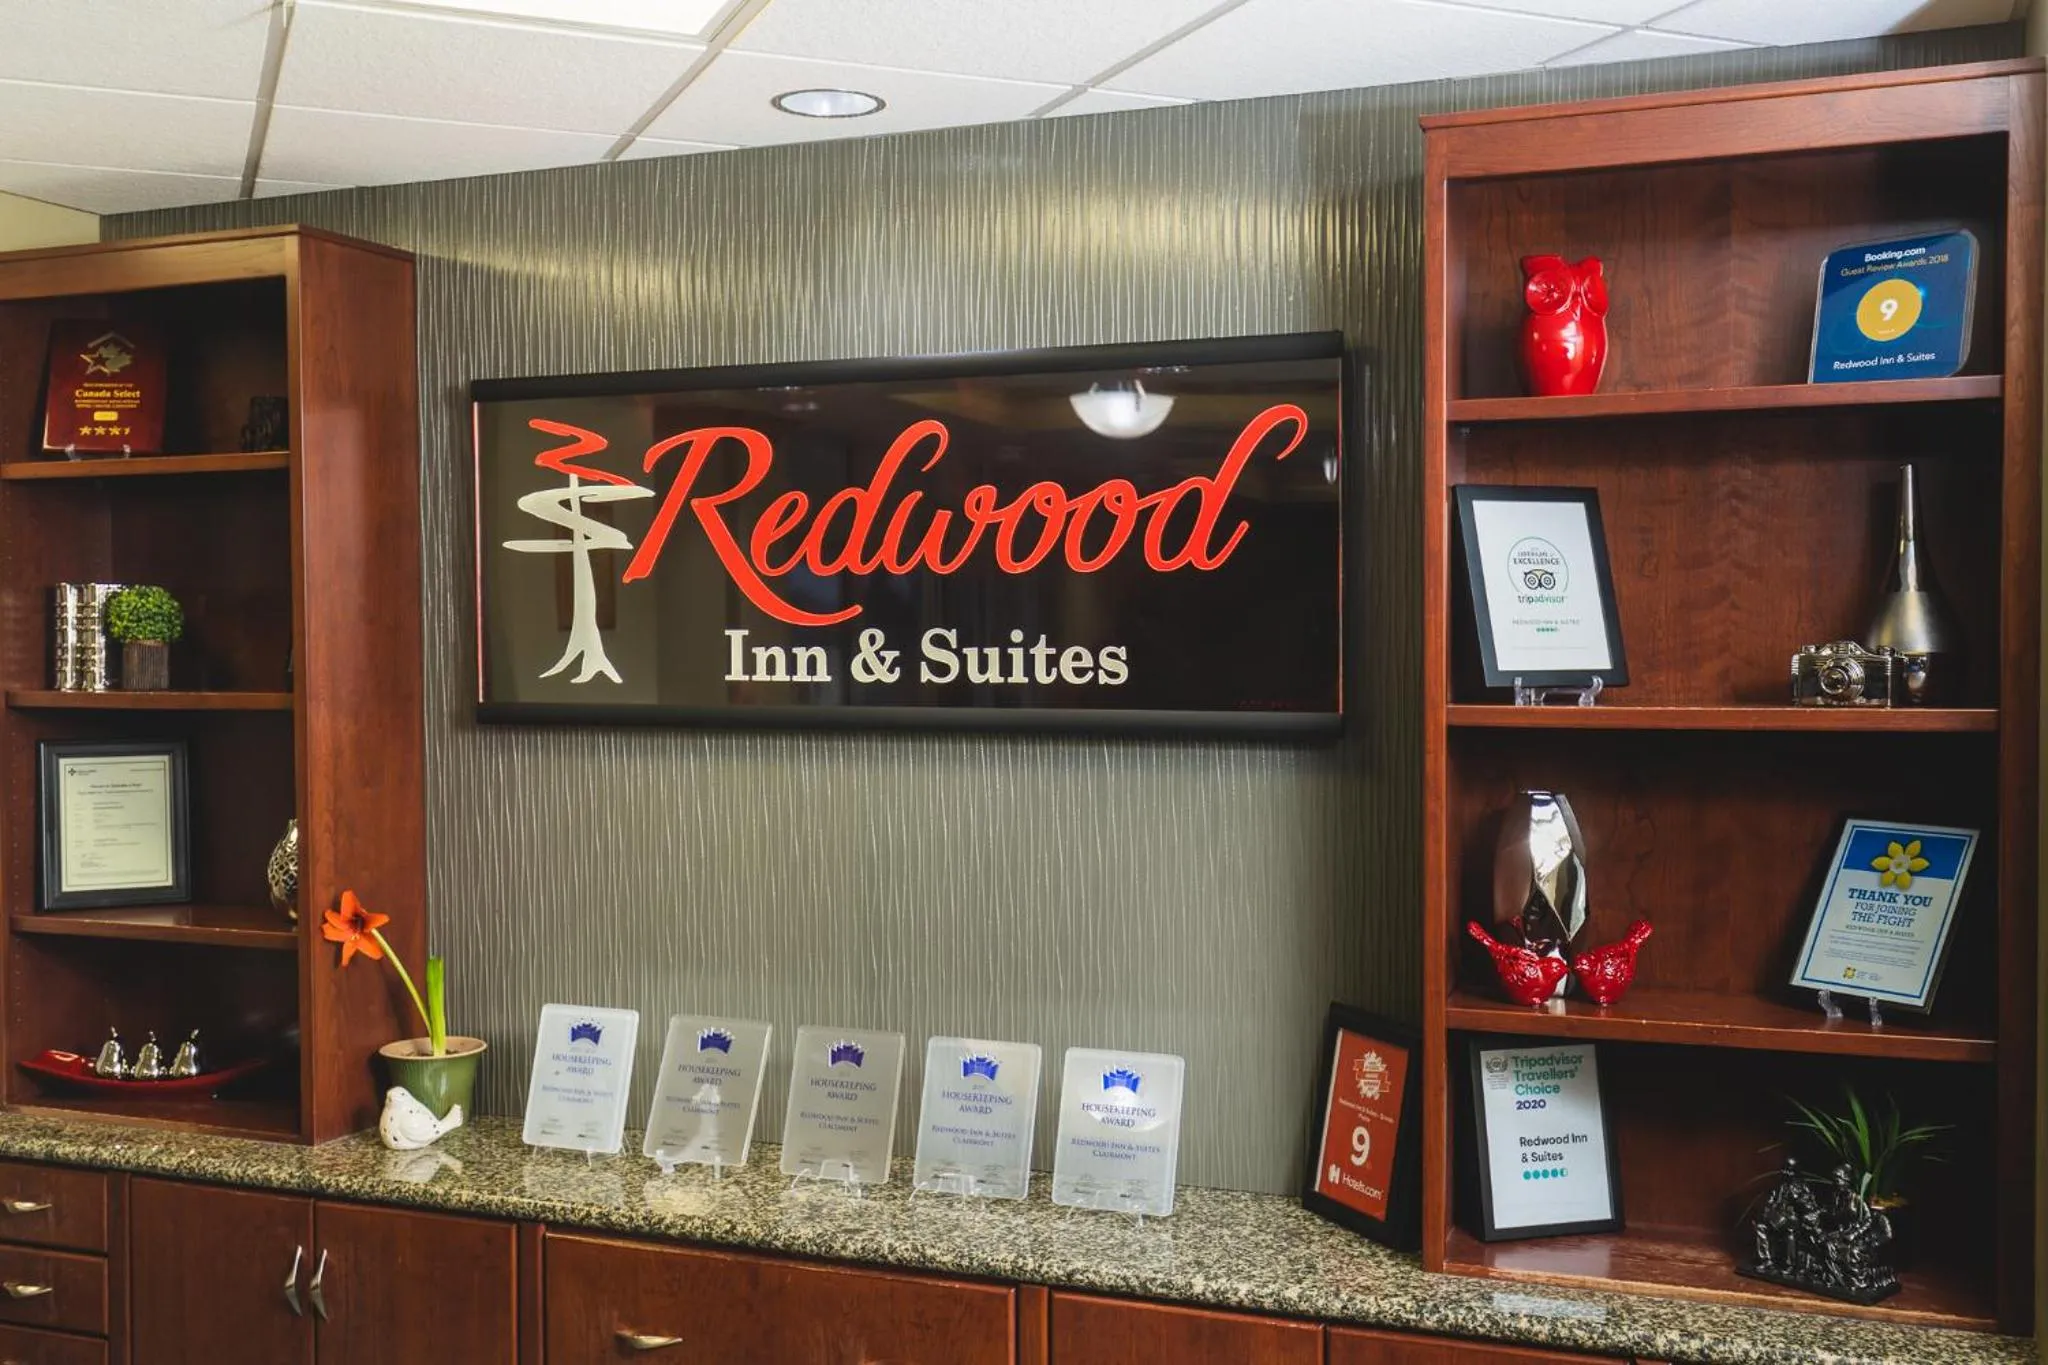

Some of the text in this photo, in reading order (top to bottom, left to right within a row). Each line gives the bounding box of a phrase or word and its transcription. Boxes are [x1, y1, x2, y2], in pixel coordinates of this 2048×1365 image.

[1864, 247, 1926, 263] Booking.com
[1840, 254, 1949, 277] Guest Review Awards 2018
[1880, 299, 1898, 321] 9
[1833, 352, 1936, 370] Redwood Inn & Suites
[75, 389, 140, 398] Canada Select
[622, 403, 1309, 627] Redwood
[1513, 558, 1560, 566] EXCELLENCE
[1517, 594, 1565, 604] tripadvisor
[724, 627, 1130, 686] Inn & Suites
[1848, 888, 1933, 908] THANK YOU
[1854, 901, 1917, 917] FOR JOINING
[1852, 911, 1914, 928] THE FIGHT
[1511, 1052, 1584, 1069] Tripadvisor
[1513, 1066, 1579, 1082] Travellers'
[941, 1089, 1013, 1105] HOUSEKEEPING
[1515, 1083, 1560, 1096] Choice
[959, 1104, 993, 1115] AWARD
[1081, 1102, 1157, 1118] HOUSEKEEPING
[1516, 1099, 1547, 1110] 2020
[1100, 1117, 1136, 1128] AWARD
[1351, 1126, 1371, 1166] 9
[1519, 1132, 1588, 1148] Redwood Inn
[1521, 1151, 1564, 1163] & Suites
[1342, 1172, 1383, 1201] Hotels.com
